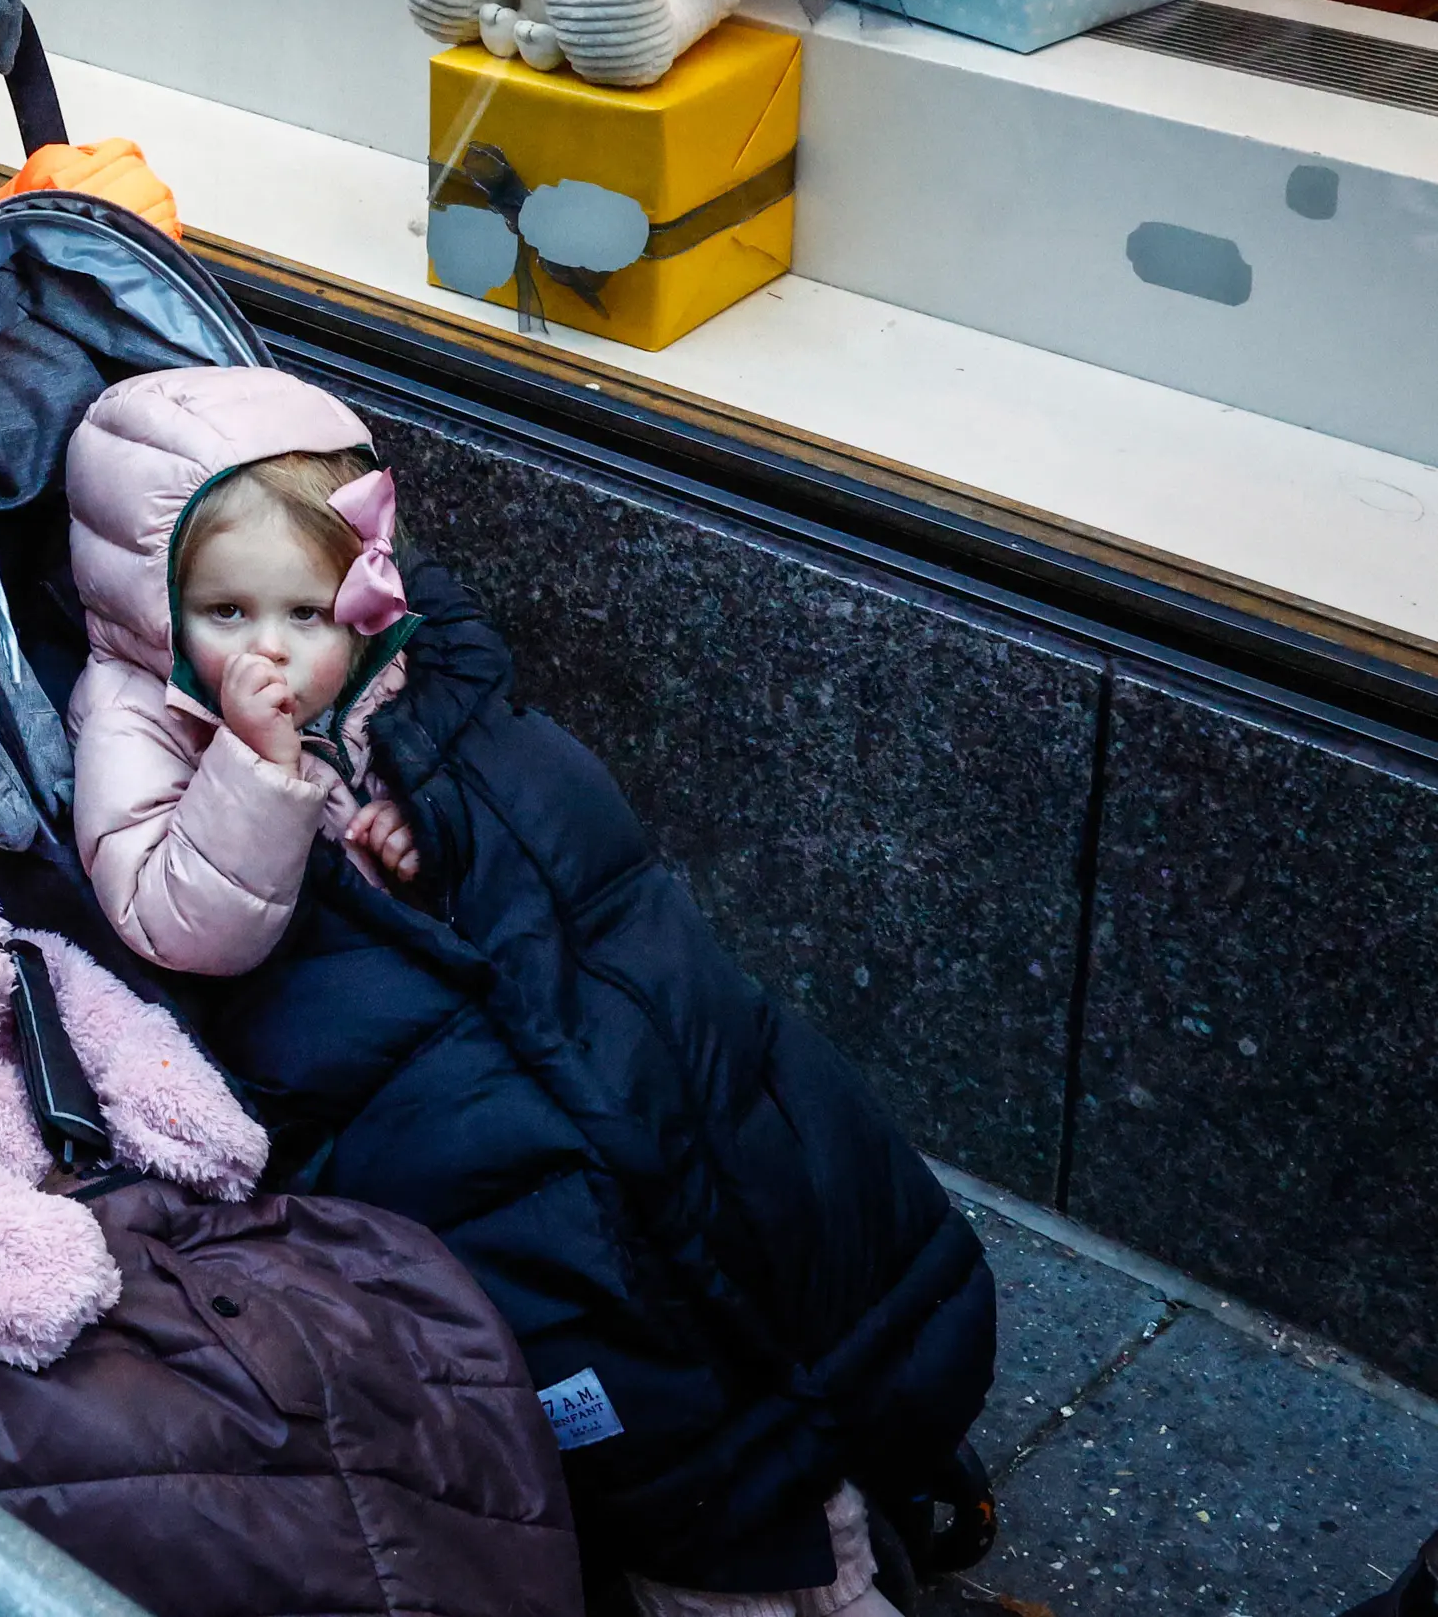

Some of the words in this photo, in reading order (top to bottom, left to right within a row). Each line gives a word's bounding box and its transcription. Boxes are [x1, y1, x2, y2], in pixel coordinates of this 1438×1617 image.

[542, 1399, 554, 1418] 7
[563, 1386, 600, 1412] A.M.
[553, 1402, 605, 1428] ENFANT
